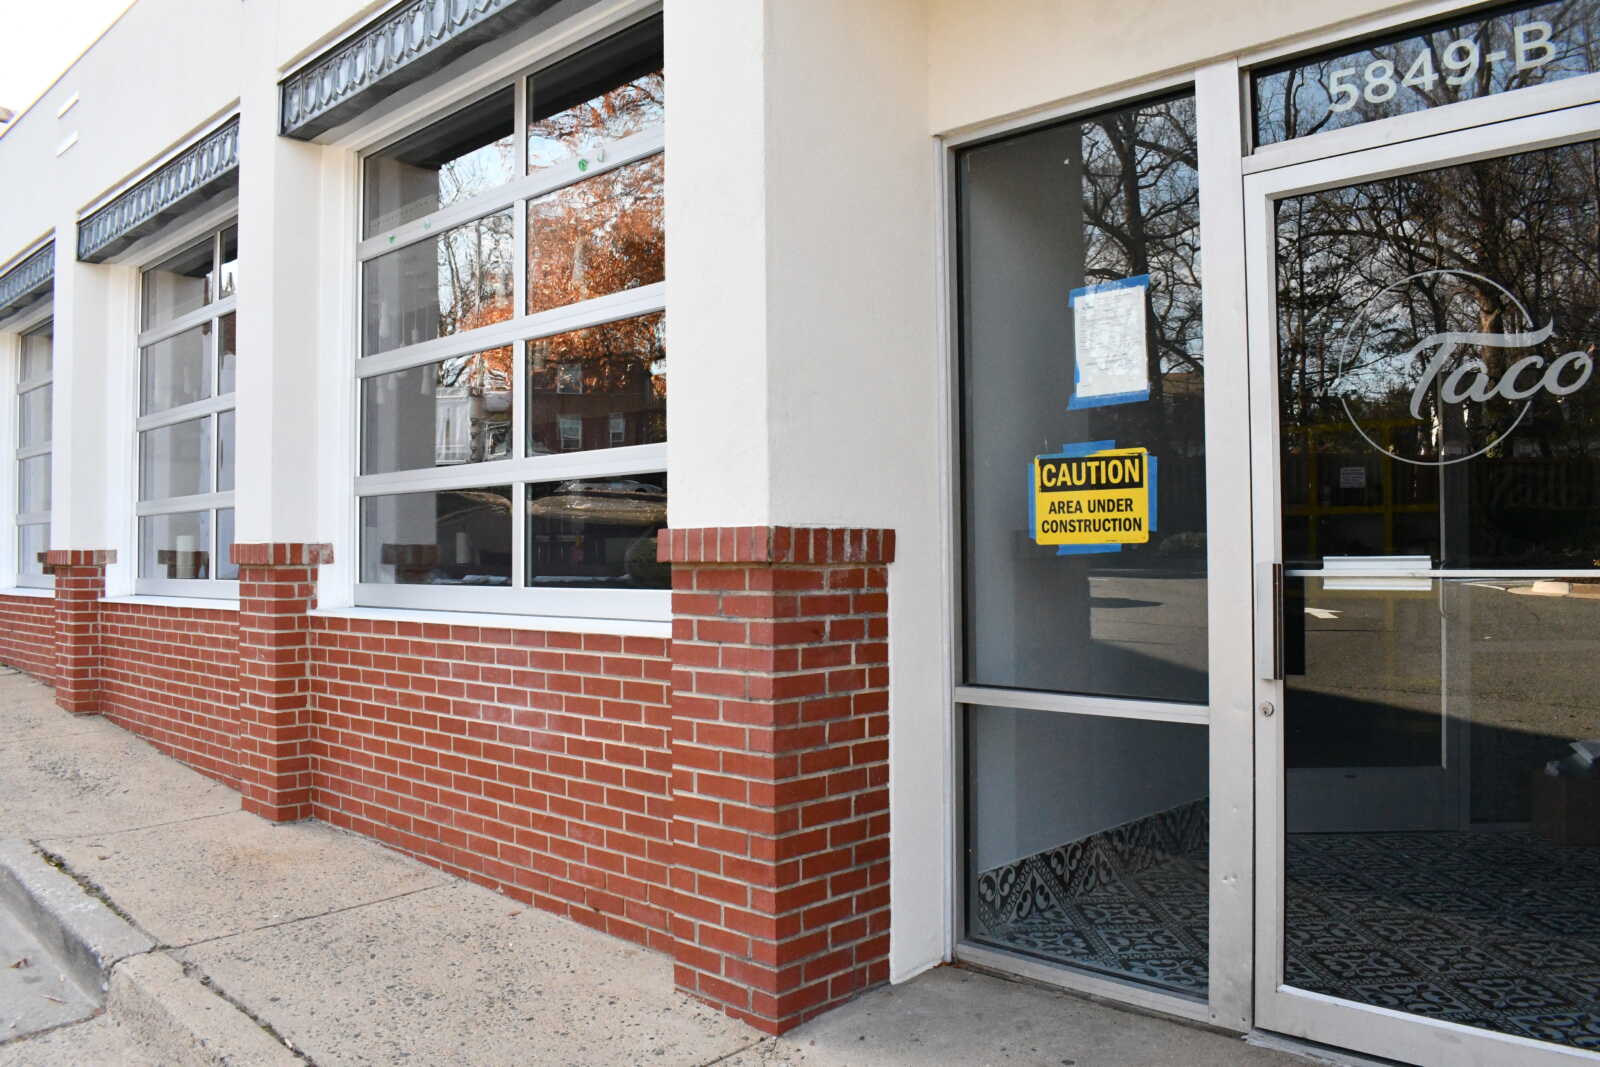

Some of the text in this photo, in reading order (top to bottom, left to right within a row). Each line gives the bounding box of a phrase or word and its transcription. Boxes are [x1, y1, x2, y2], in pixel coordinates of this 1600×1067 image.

[1328, 21, 1556, 113] 5849-B
[1407, 319, 1593, 420] Taco
[1042, 458, 1140, 487] CAUTION
[1048, 498, 1134, 514] AREA UNDER
[1041, 517, 1143, 534] CONSTRUCTION
